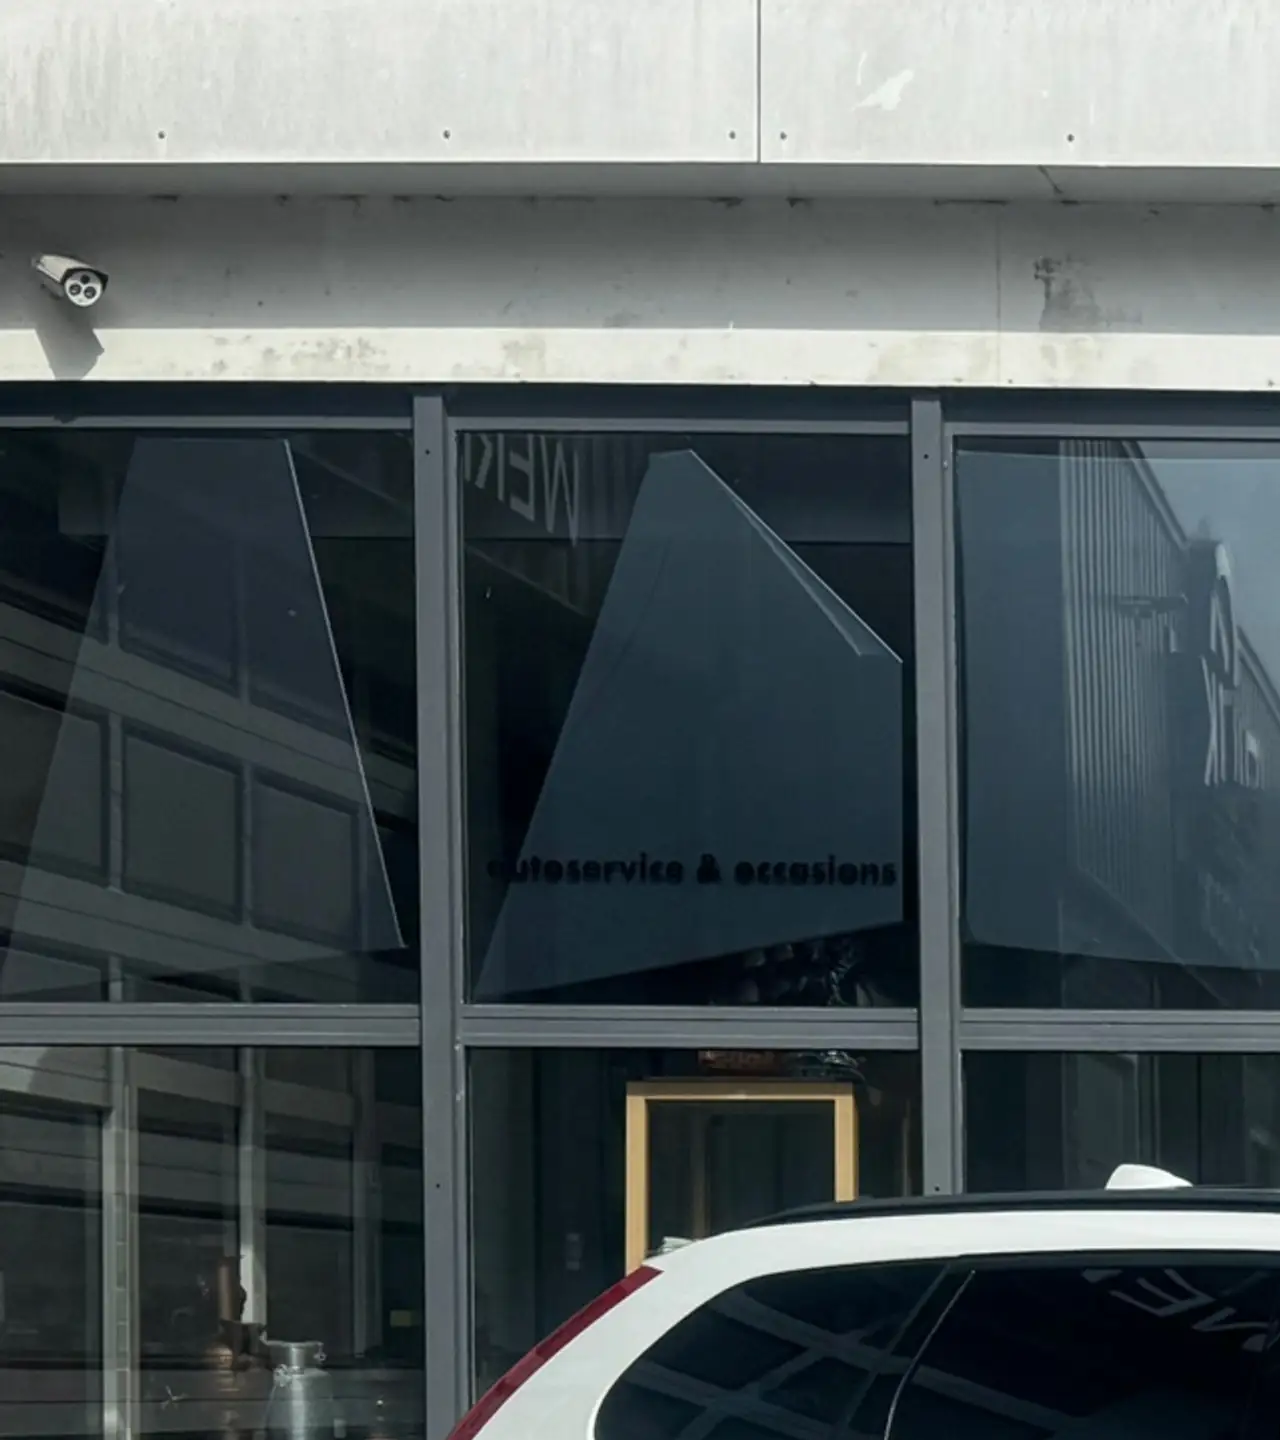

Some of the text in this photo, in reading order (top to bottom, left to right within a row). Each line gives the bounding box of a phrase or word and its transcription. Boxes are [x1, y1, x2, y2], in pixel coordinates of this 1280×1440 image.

[486, 852, 898, 887] autoservice & occasions
